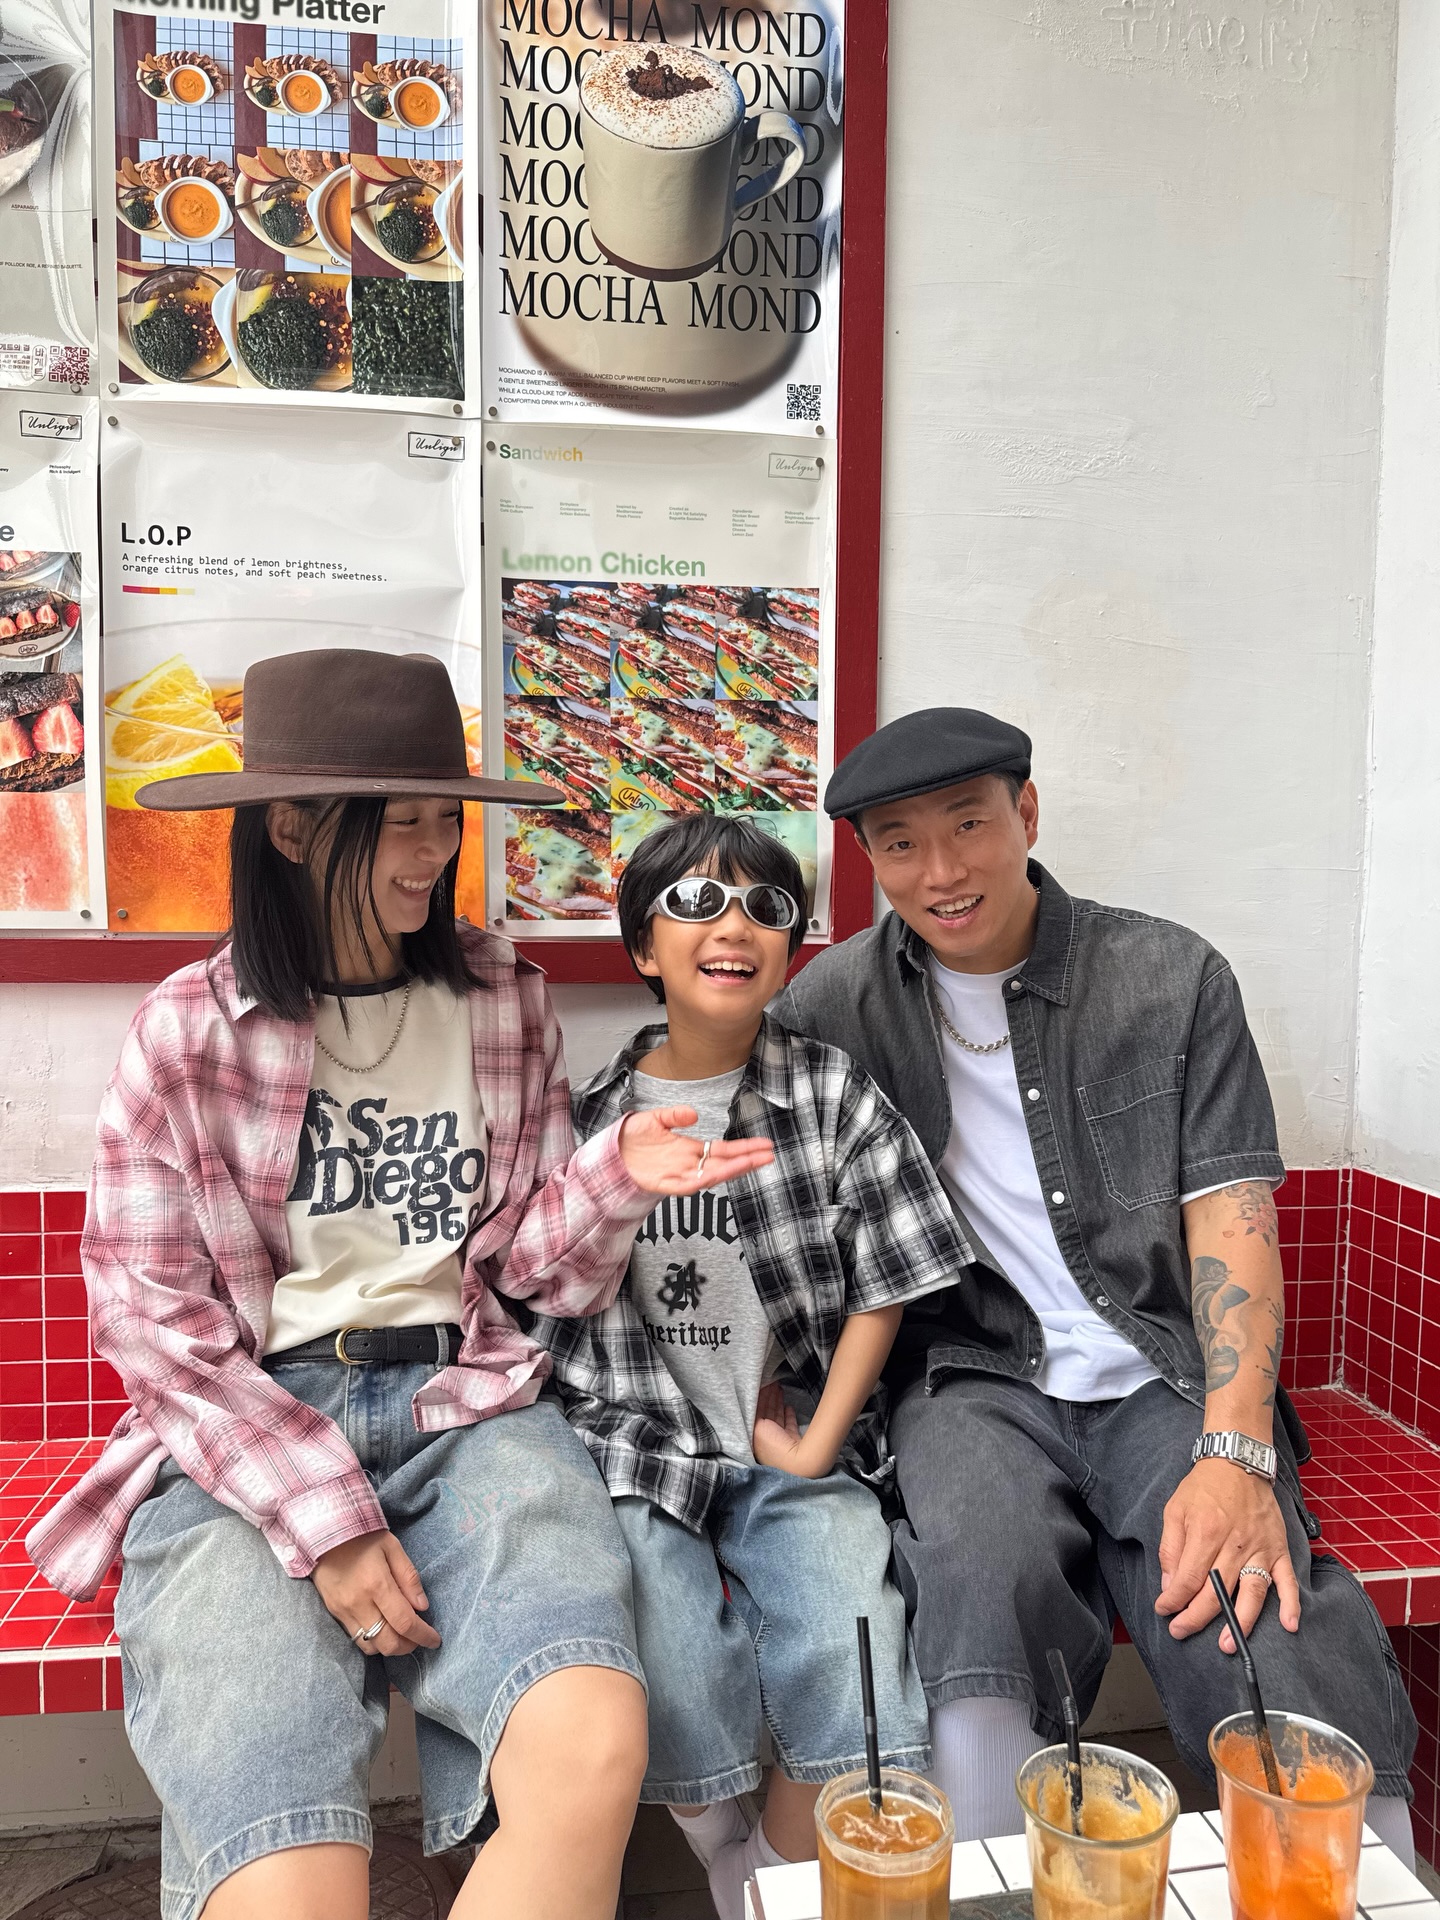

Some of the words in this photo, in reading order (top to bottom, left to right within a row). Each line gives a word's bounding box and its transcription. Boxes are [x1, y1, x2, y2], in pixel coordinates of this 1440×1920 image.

[273, 0, 385, 24] Platter
[500, 0, 667, 43] MOCHA
[691, 2, 826, 58] MOND
[718, 60, 826, 112] OND
[499, 267, 667, 326] MOCHA
[688, 281, 822, 334] MOND
[34, 348, 44, 376] 바게트
[499, 367, 536, 375] MOCHAMOND
[568, 372, 613, 380] WELL-BALANCED
[500, 444, 583, 462] Sandwich
[121, 522, 192, 546] L.O.P
[122, 553, 129, 561] A
[135, 554, 194, 566] refreshing
[199, 556, 228, 566] blend
[234, 557, 246, 566] of
[252, 558, 280, 568] lemon
[286, 559, 348, 571] brightness,
[122, 565, 158, 575] orange
[165, 564, 199, 575] citrus
[205, 566, 238, 577] notes,
[246, 567, 262, 577] and
[269, 568, 291, 578] soft
[297, 569, 326, 580] peach
[332, 571, 388, 582] sweetness.
[502, 547, 592, 574] Lemon
[600, 551, 706, 577] Chicken
[347, 1098, 460, 1158] San
[307, 1146, 486, 1216] Diego
[642, 1315, 732, 1352] heritage
